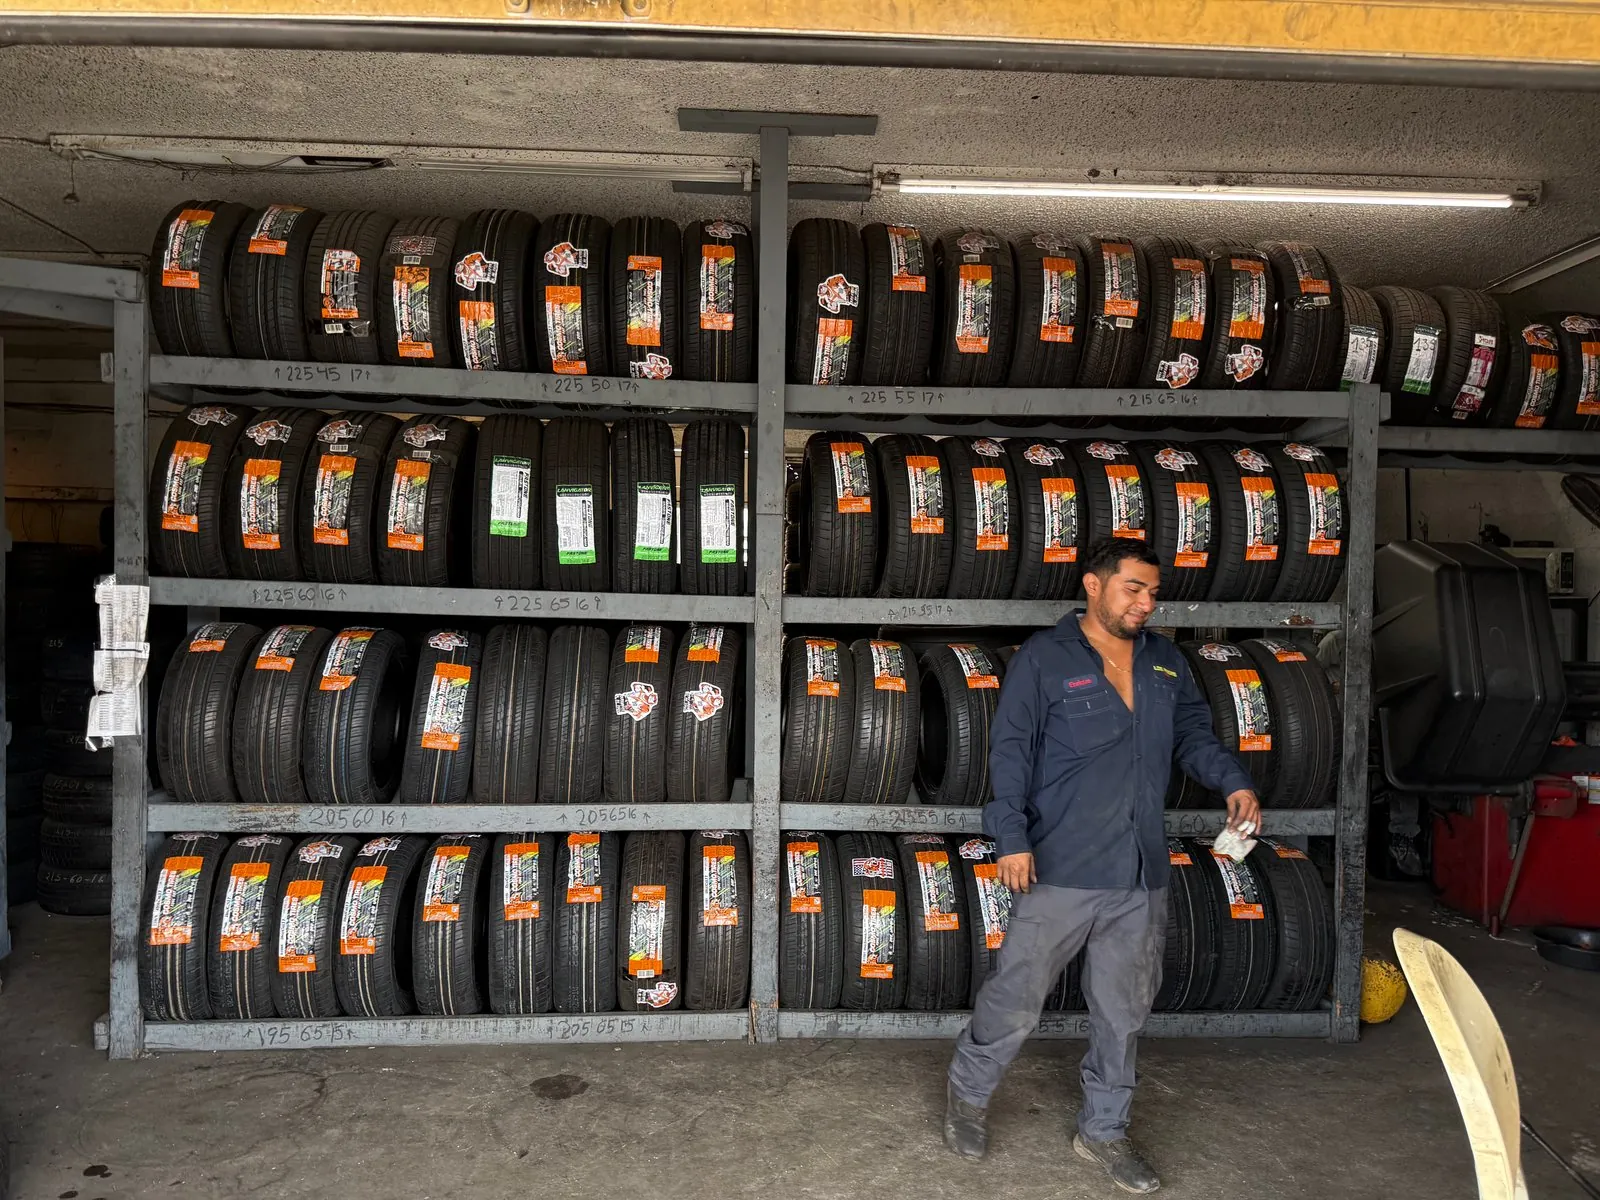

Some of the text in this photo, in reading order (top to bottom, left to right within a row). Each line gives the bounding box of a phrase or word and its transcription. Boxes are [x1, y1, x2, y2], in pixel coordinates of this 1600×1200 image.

[172, 235, 182, 258] COSMO
[555, 325, 564, 350] COSMO
[470, 340, 479, 364] COSMO
[351, 368, 362, 382] 17
[821, 355, 830, 379] COSMO
[555, 378, 631, 393] 225 50 17
[1530, 385, 1540, 407] COSMO
[861, 391, 934, 405] 225 55 17
[1129, 393, 1190, 407] 215 65 16
[842, 465, 850, 487] COSMO
[170, 475, 179, 502] COSMO
[917, 483, 925, 507] COSMO
[321, 490, 329, 517] COSMO
[396, 495, 405, 522] COSMO
[1119, 495, 1127, 519] COSMO
[264, 588, 335, 602] 225 60 16
[508, 595, 590, 612] 225 65 16
[1243, 700, 1252, 724] COSMO
[309, 808, 395, 829] 205 60 16
[944, 811, 956, 826] 16
[434, 871, 442, 894] COSMO
[795, 864, 803, 887] COSMO
[162, 888, 172, 915] COSMO
[928, 878, 937, 903] COSMO
[231, 894, 242, 922] COSMO
[349, 900, 358, 926] COSMO
[987, 895, 998, 922] COSMO
[258, 1026, 291, 1046] 195
[300, 1025, 325, 1041] 65
[1074, 1020, 1088, 1034] 16
